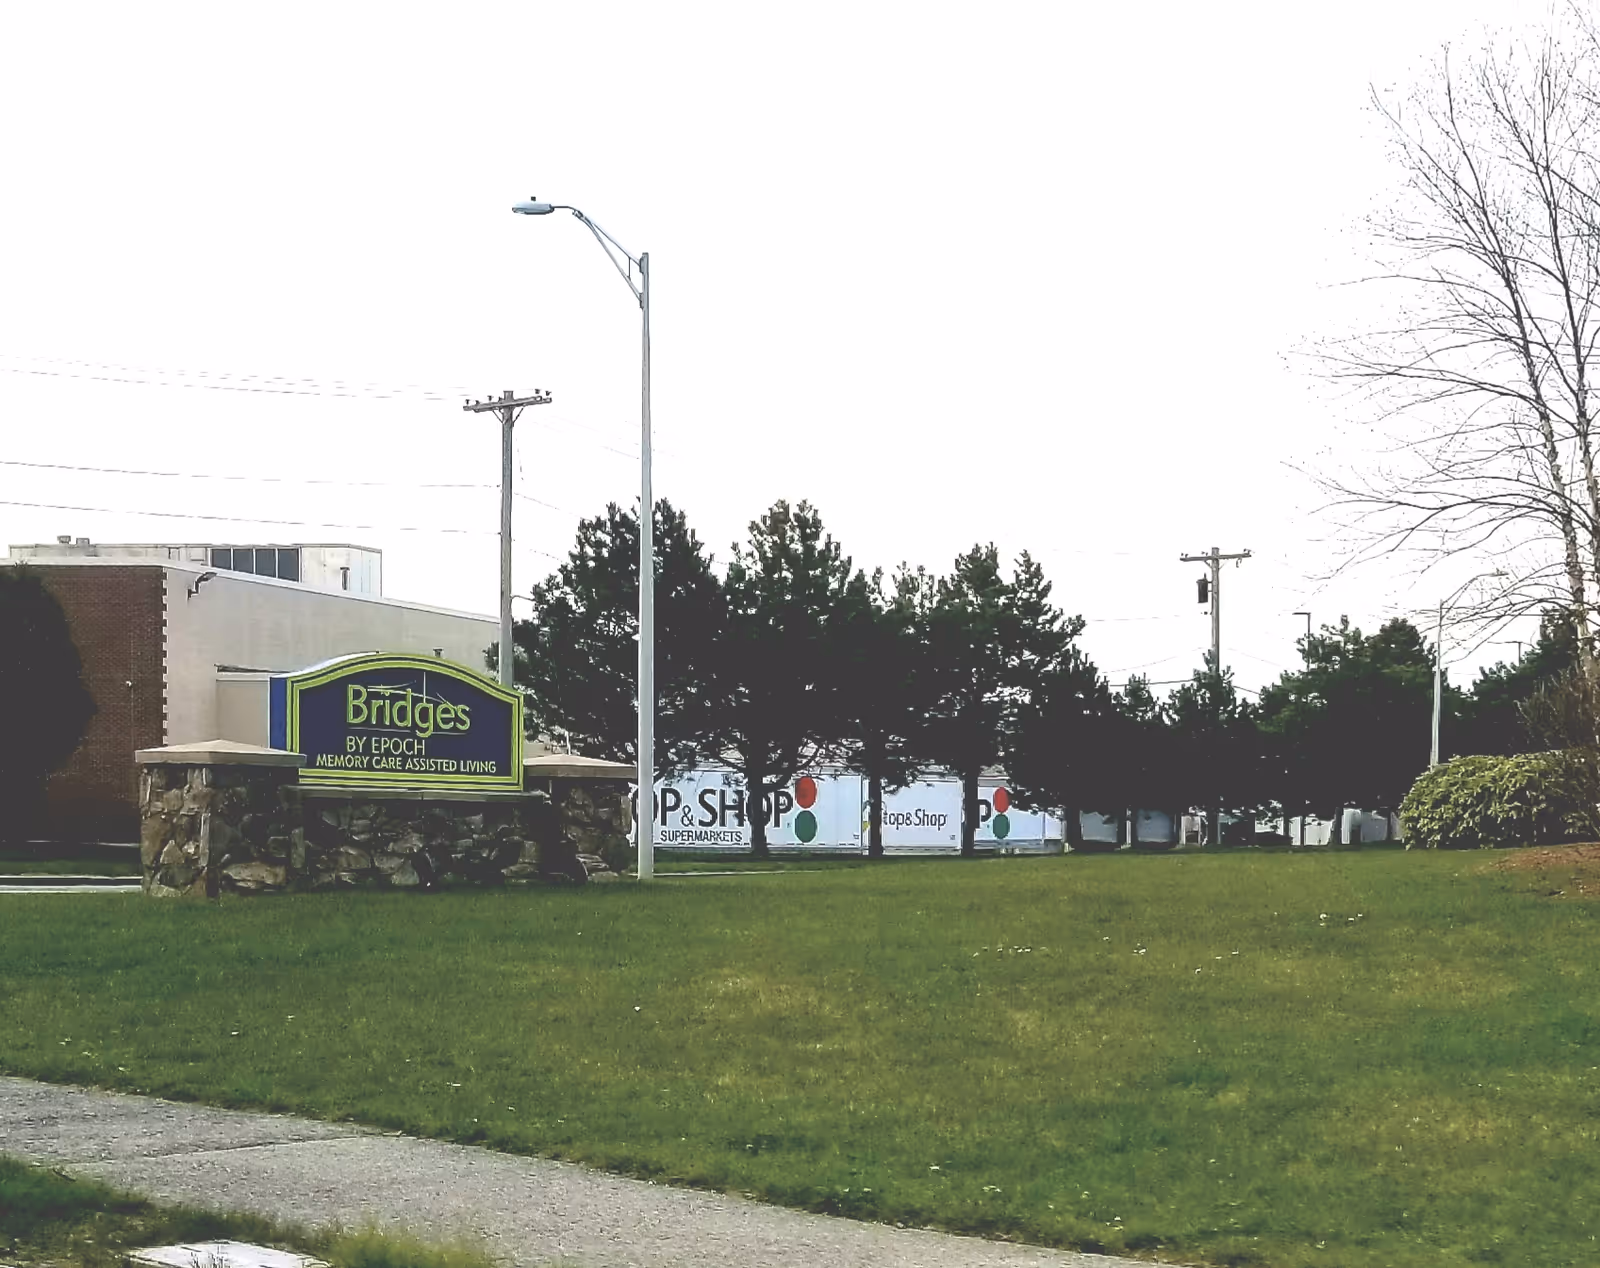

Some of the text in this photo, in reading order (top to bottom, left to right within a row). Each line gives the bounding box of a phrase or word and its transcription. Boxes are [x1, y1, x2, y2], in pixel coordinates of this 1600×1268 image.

[347, 684, 470, 737] Bridges
[346, 736, 425, 755] BY EPOCH
[316, 754, 496, 773] MEMORY CARE ASSISTED LIVING
[660, 830, 743, 842] SUPERMARKETS
